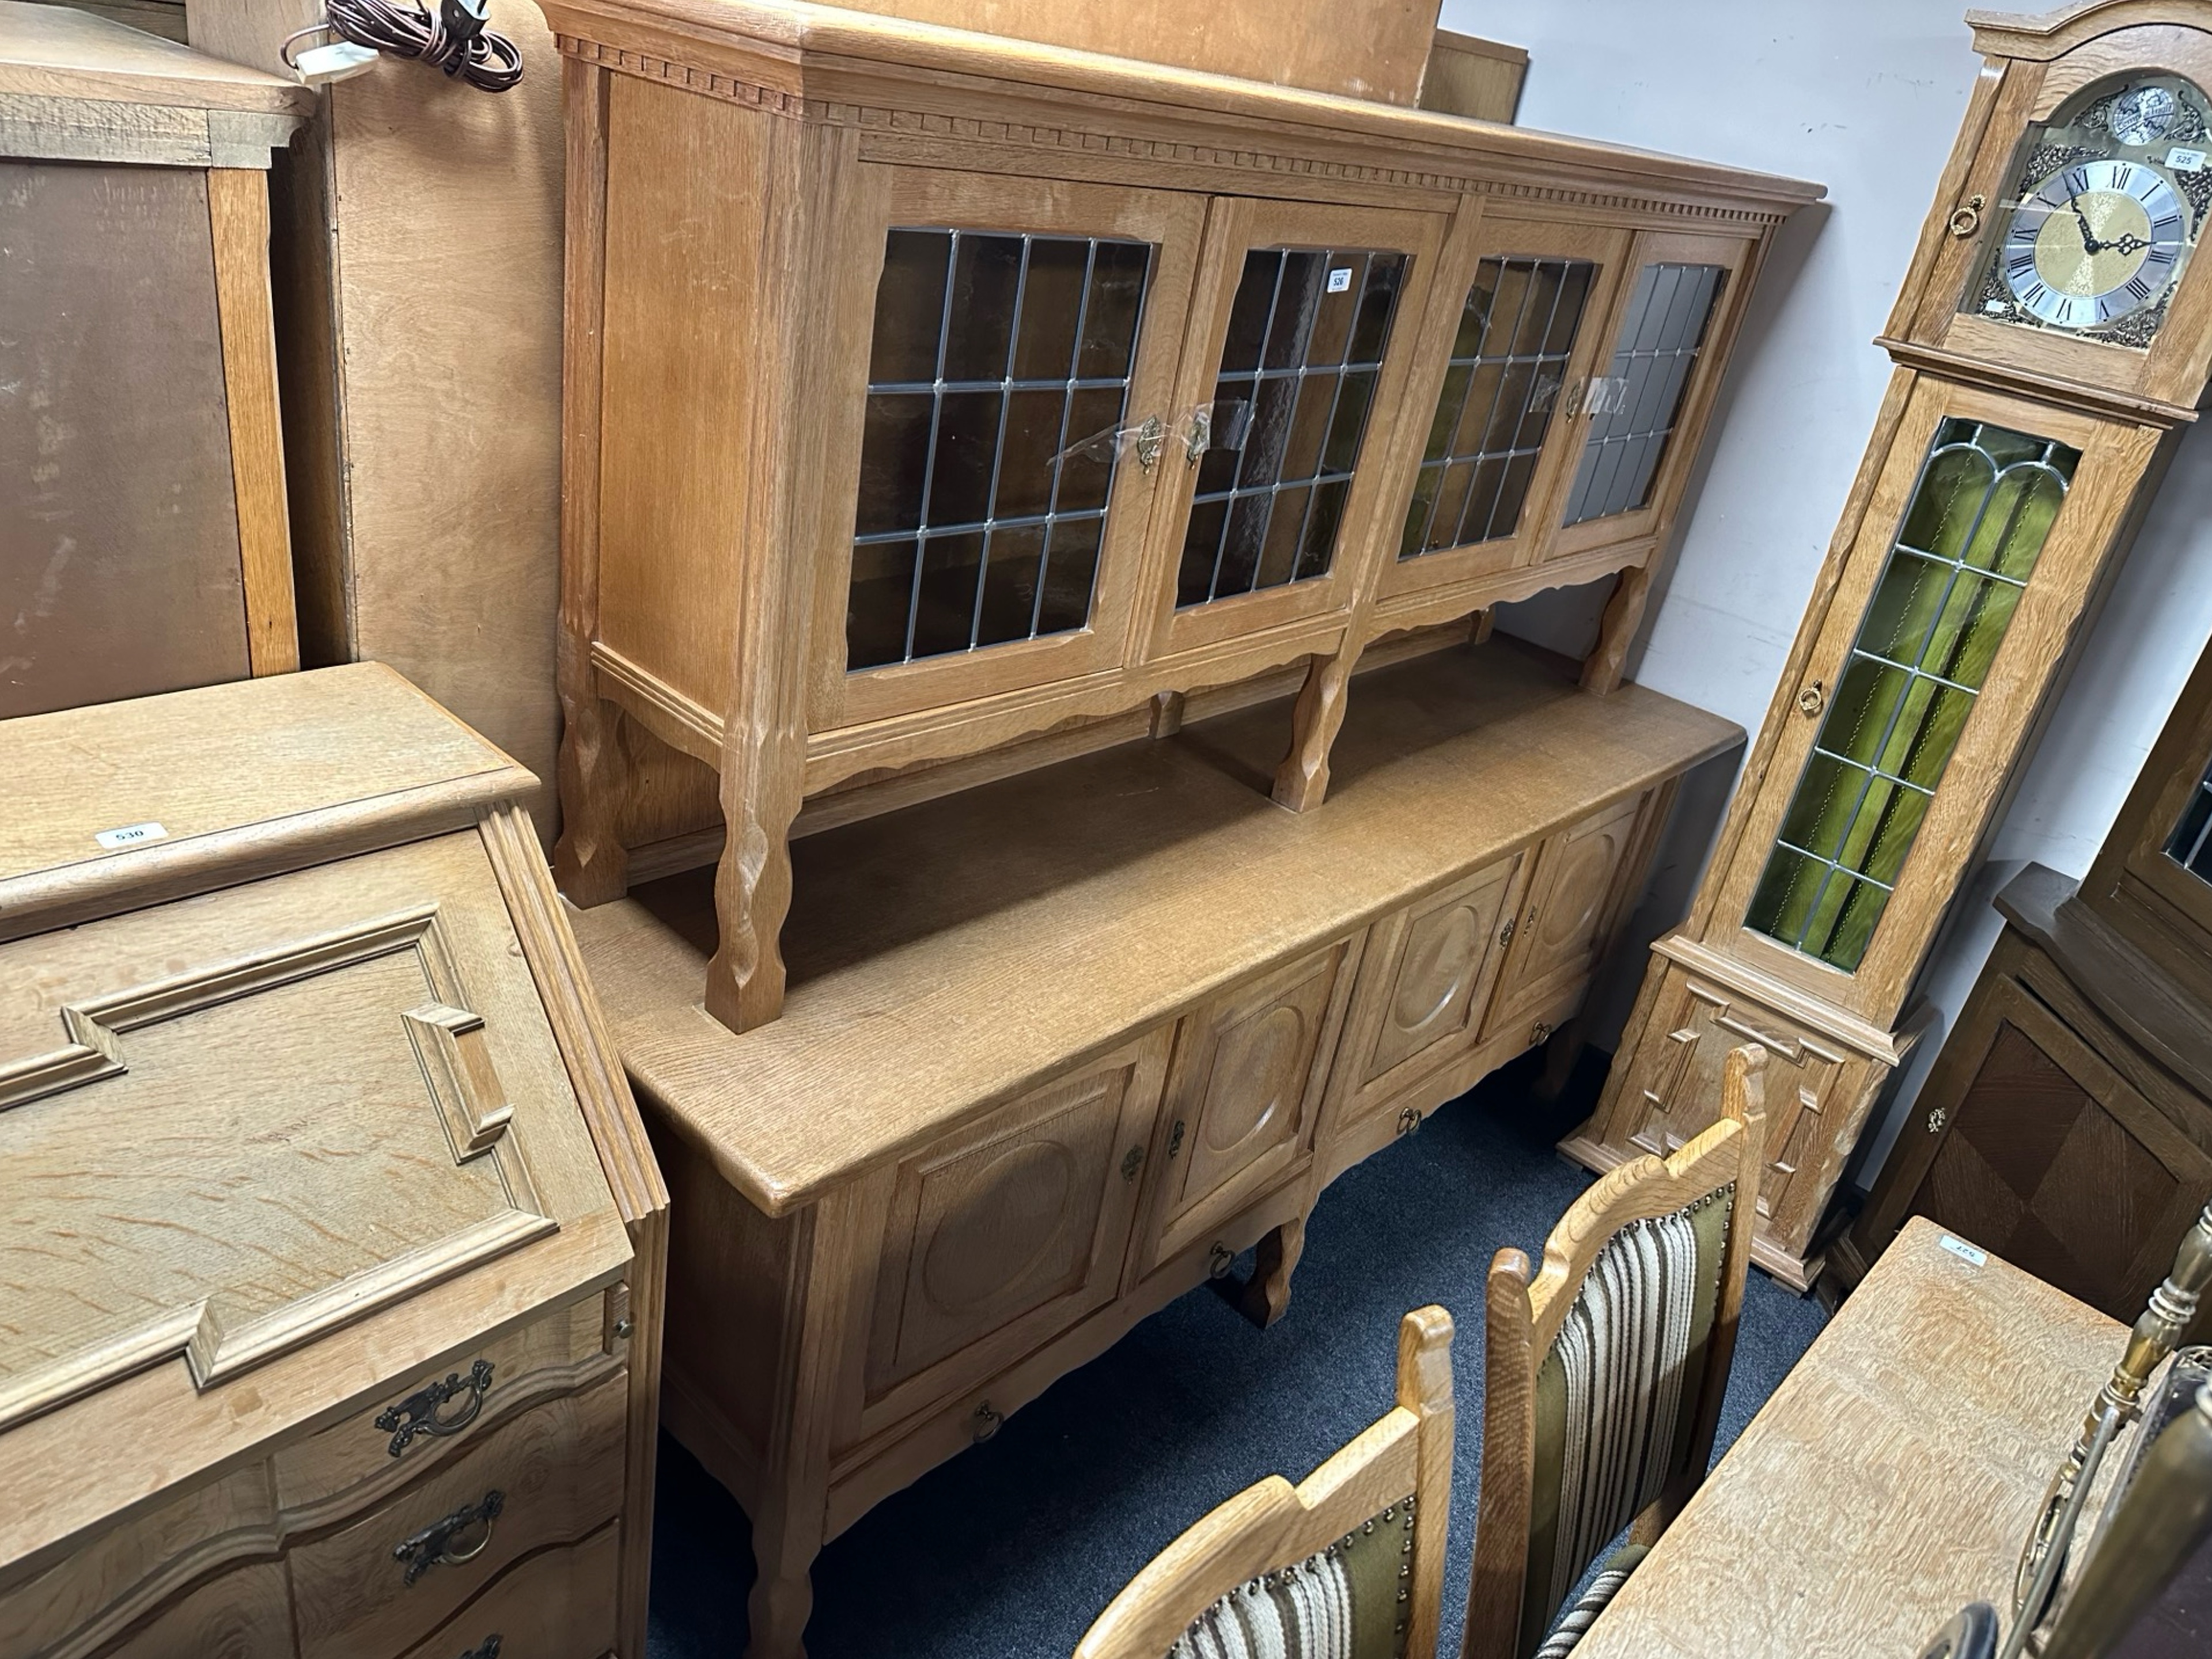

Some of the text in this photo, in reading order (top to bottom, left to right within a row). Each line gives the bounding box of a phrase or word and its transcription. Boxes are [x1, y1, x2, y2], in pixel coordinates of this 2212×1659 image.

[2175, 156, 2192, 164] 525
[2073, 168, 2089, 191] XI
[2105, 166, 2131, 190] XII
[1334, 277, 1344, 286] 526
[116, 830, 144, 840] 530
